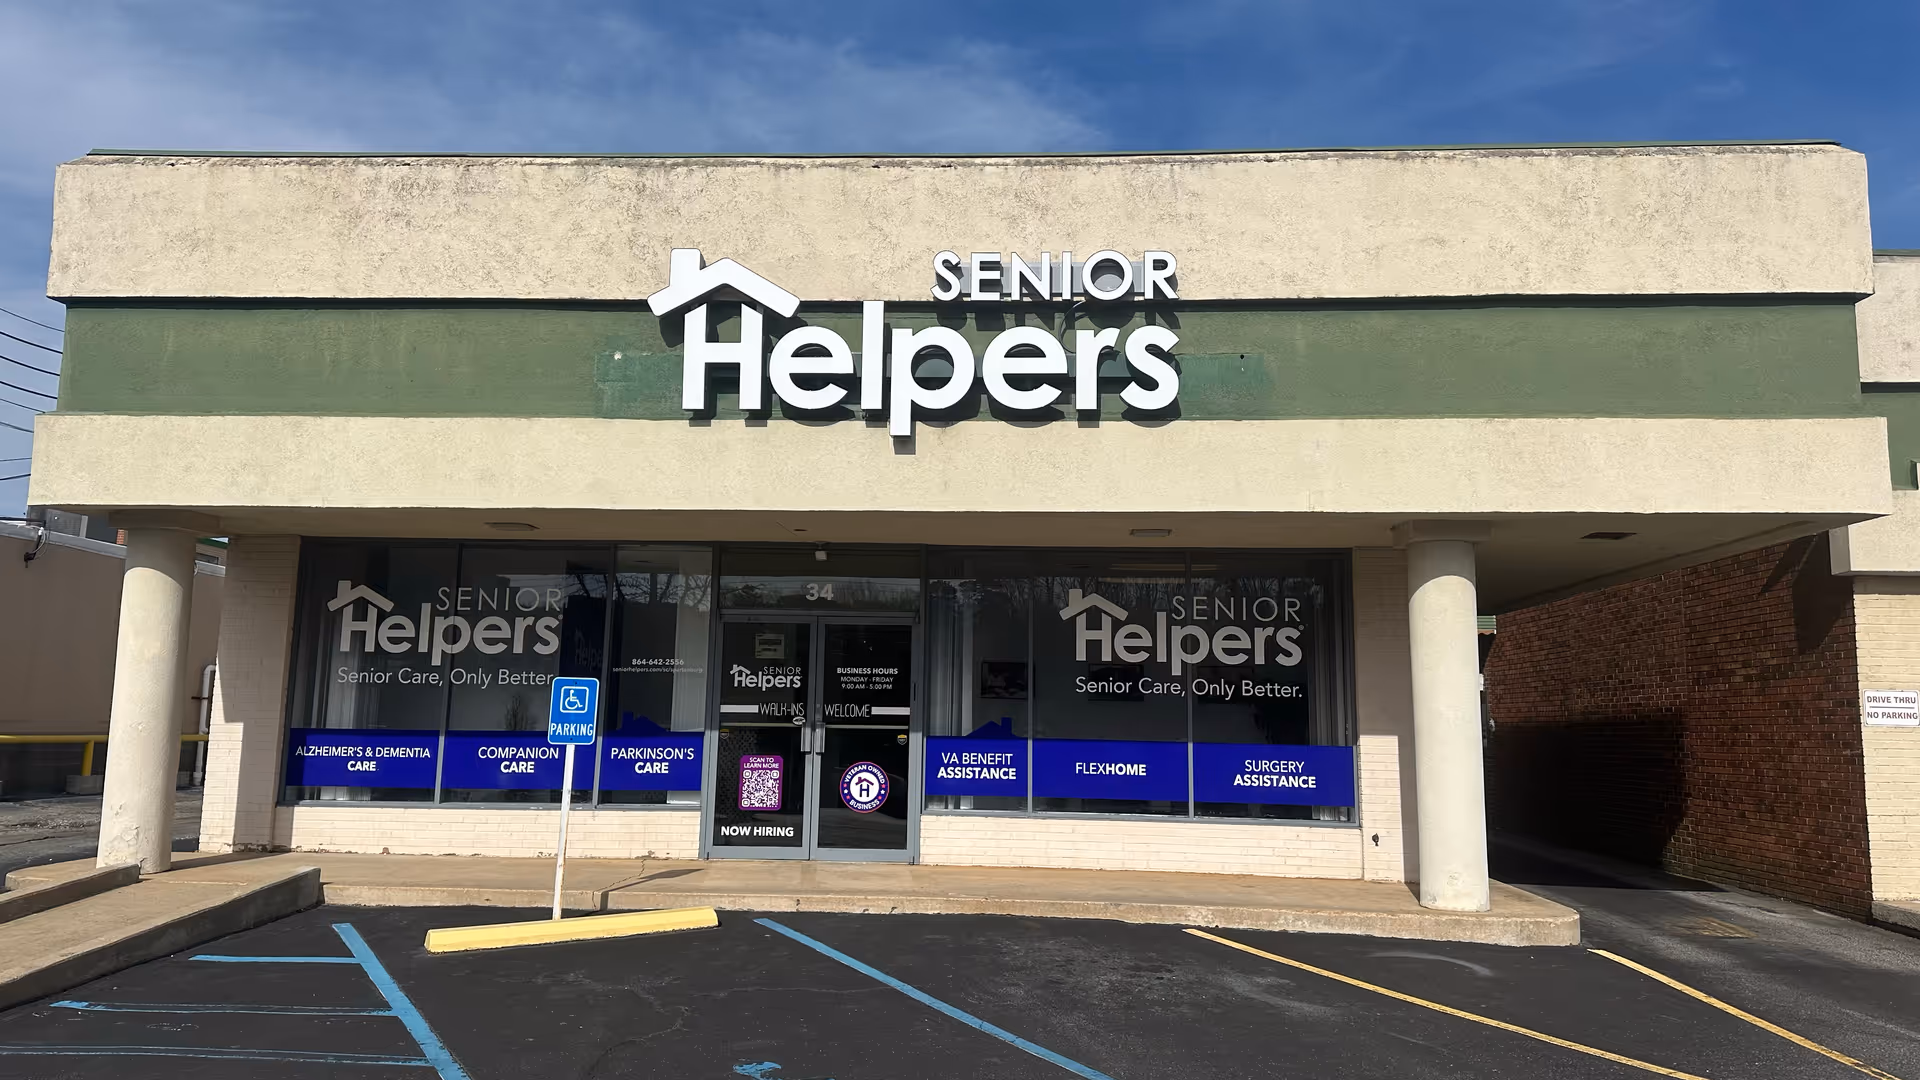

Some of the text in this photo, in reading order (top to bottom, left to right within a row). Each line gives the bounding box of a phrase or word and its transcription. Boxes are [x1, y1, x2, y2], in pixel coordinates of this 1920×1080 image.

[931, 250, 1179, 301] SENIOR
[682, 300, 1181, 436] Helpers
[436, 586, 562, 612] SENIOR
[806, 583, 834, 601] 34
[1171, 595, 1301, 622] SENIOR
[631, 658, 685, 666] 864-642-2556
[763, 666, 802, 675] SENIOR
[836, 667, 899, 675] BUSINESS HOURS
[337, 666, 393, 685] Senior
[398, 667, 443, 688] Care,
[450, 667, 493, 690] Only
[733, 671, 802, 692] Helpers
[1075, 676, 1303, 701] Senior Care, Only Better.
[1894, 696, 1916, 704] THRU
[759, 702, 871, 718] WALK-INS WELCOME
[550, 722, 594, 737] PARKING
[295, 745, 431, 758] ALZHEIMER'S & DEMENTIA
[478, 746, 559, 759] COMPANION
[610, 747, 695, 760] PARKINSON'S
[347, 760, 377, 772] CARE
[941, 752, 1014, 766] VA BENEFIT
[1244, 759, 1305, 773] SURGERY
[499, 761, 535, 773] CARE
[634, 761, 669, 774] CARE
[844, 764, 886, 784] VETERAN OWNED
[936, 766, 1017, 780] ASSISTANCE
[1075, 762, 1147, 776] FLEXHOME
[1233, 774, 1317, 788] ASSISTANCE
[859, 783, 870, 798] H
[849, 798, 880, 810] BUSINESS
[720, 825, 794, 837] NOW HIRING
